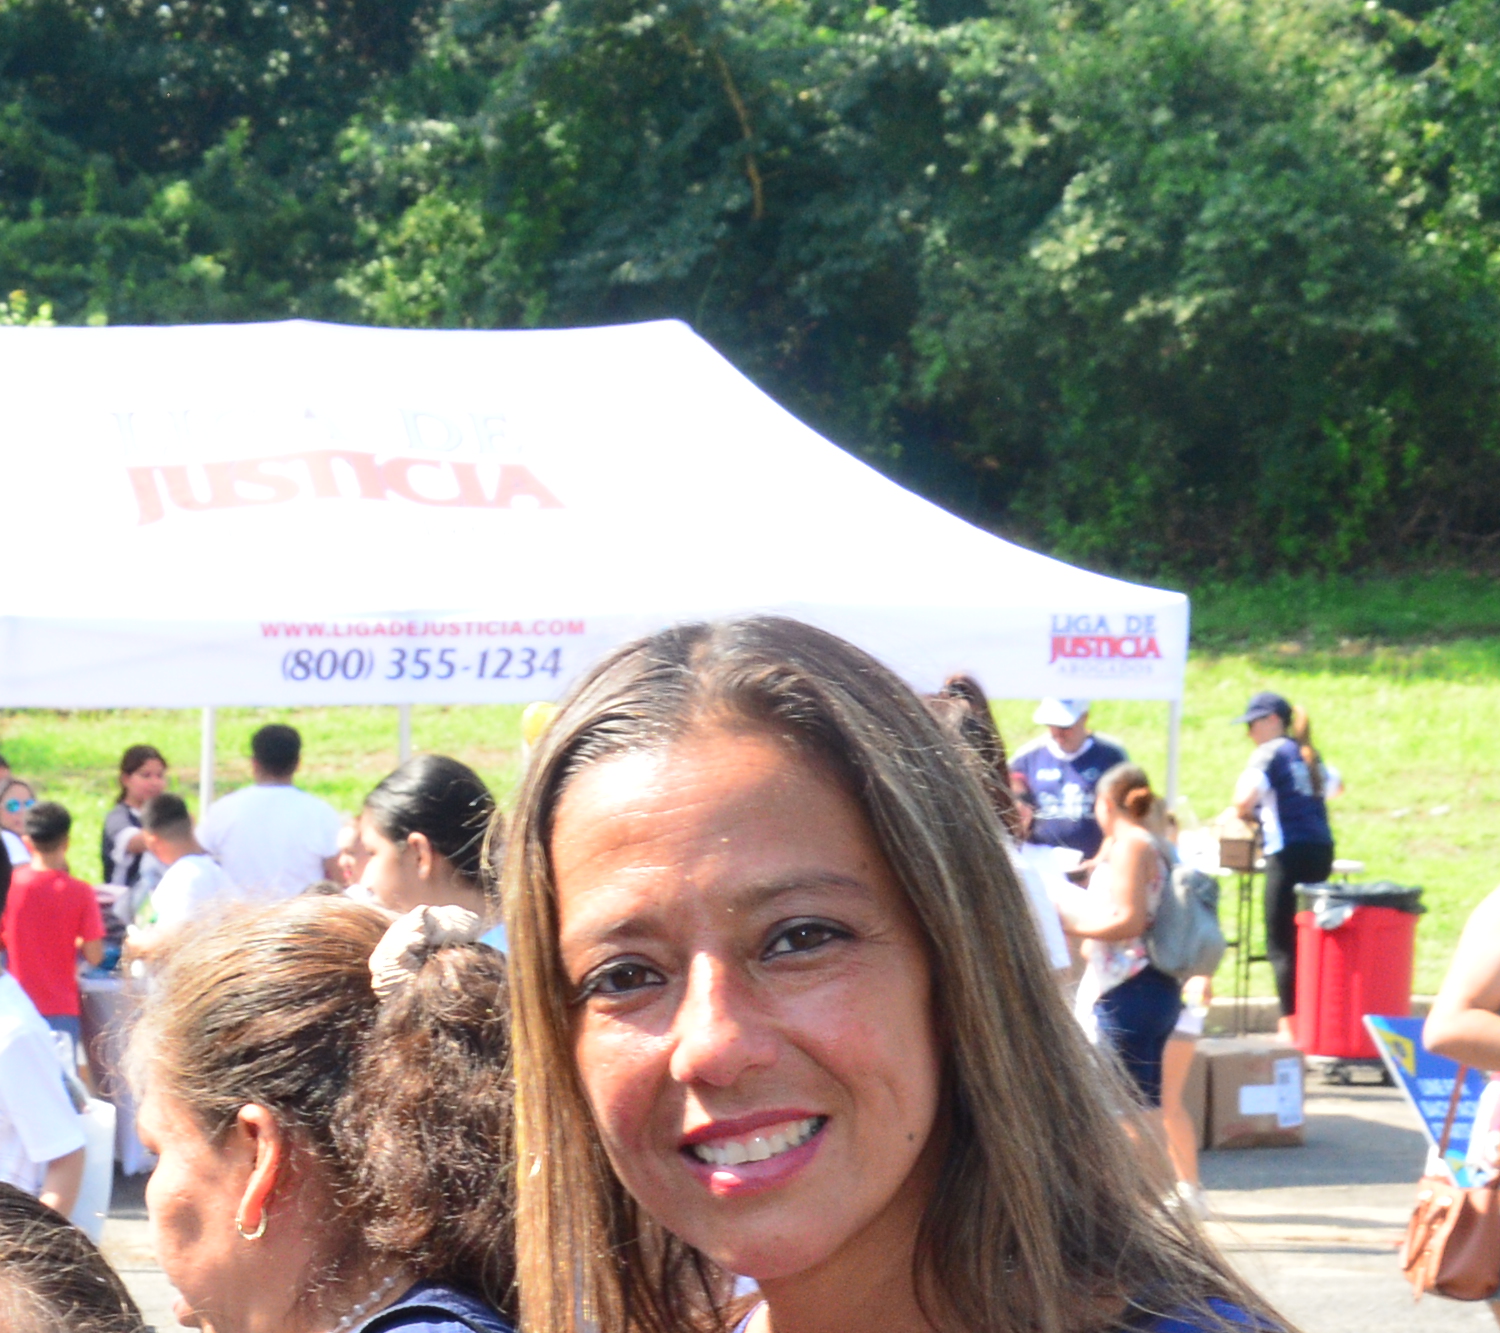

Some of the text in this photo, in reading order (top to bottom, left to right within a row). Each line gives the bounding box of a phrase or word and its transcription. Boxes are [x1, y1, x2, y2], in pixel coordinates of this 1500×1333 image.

[125, 449, 567, 526] JUSTICIA
[260, 619, 586, 638] WWW.LIGADEJUSTICIA.COM
[1051, 613, 1158, 634] LIGA DE
[281, 647, 564, 681] (800) 355-1234
[1049, 636, 1162, 664] JUSTICIA
